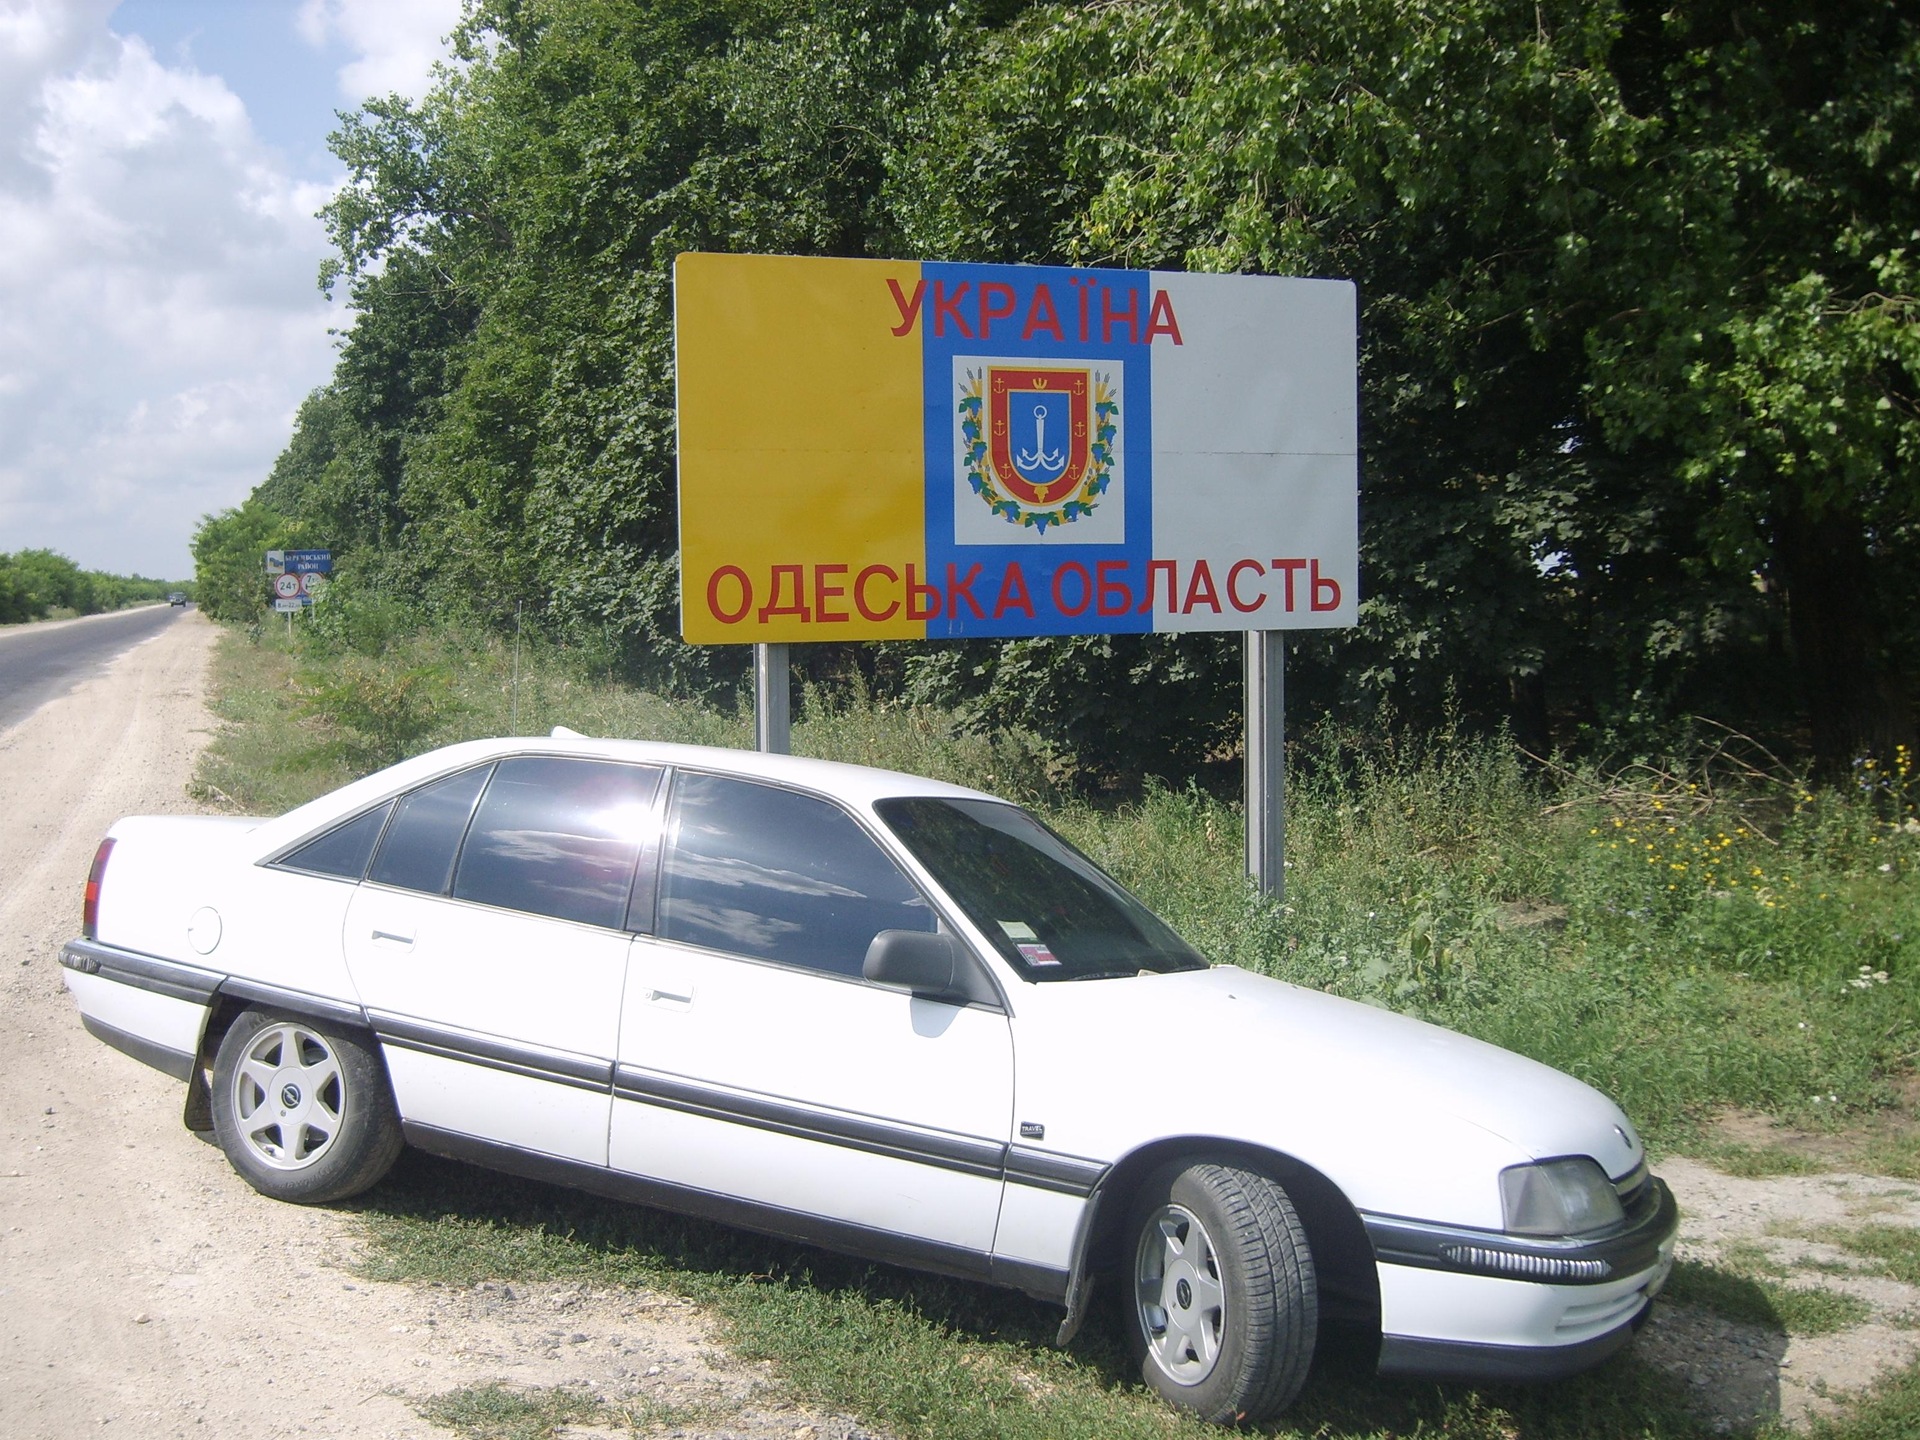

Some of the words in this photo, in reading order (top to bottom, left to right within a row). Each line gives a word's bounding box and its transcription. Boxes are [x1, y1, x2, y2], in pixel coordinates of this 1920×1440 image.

[886, 277, 1184, 346] УКРАЇНА
[706, 562, 1036, 624] ОДЕСЬКА
[1051, 559, 1342, 617] ОБЛАСТЬ
